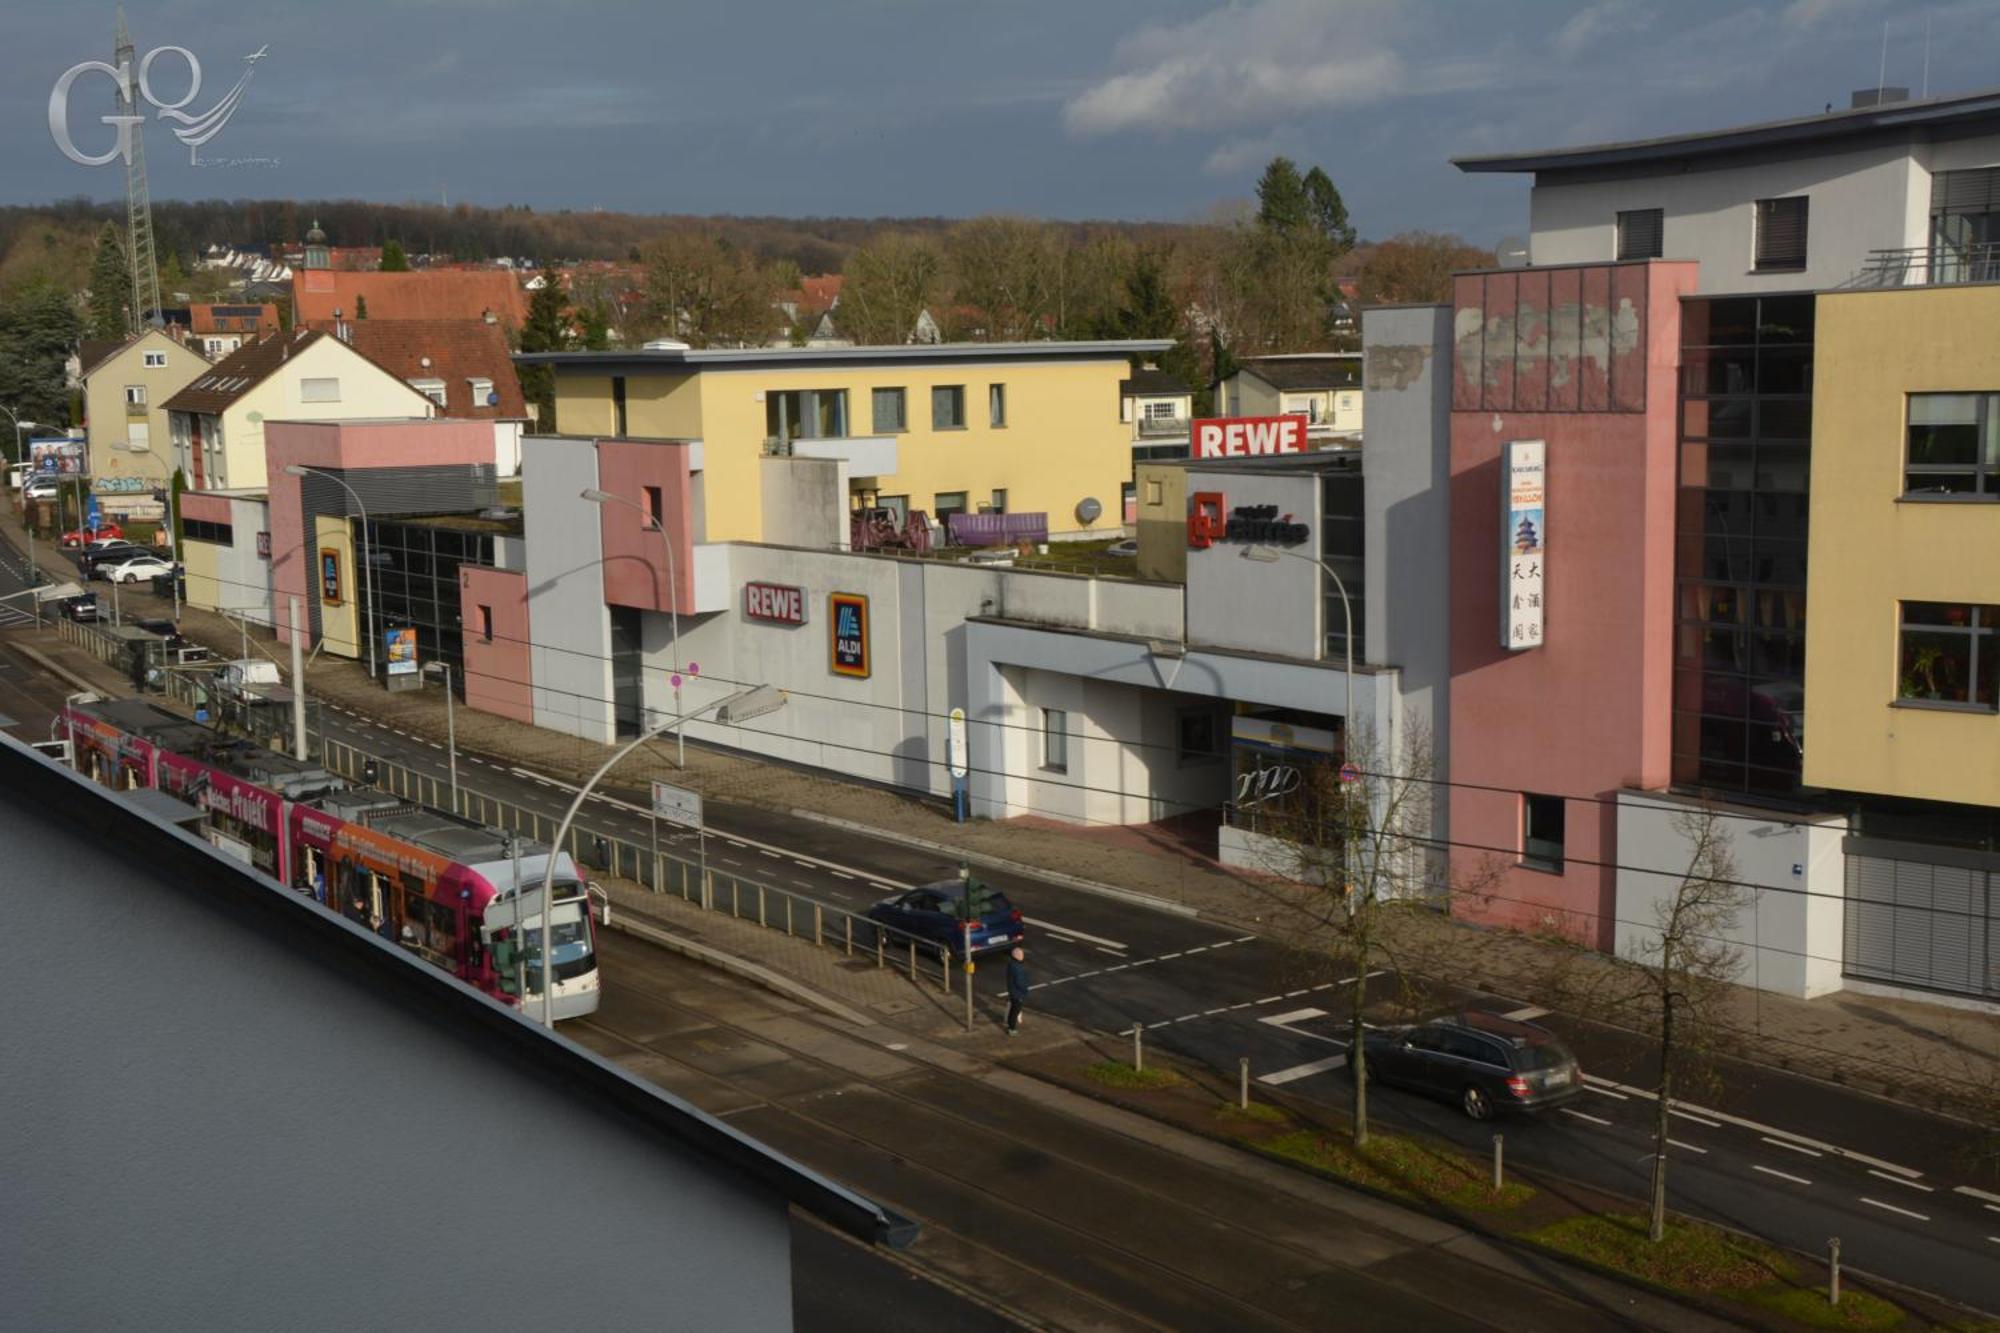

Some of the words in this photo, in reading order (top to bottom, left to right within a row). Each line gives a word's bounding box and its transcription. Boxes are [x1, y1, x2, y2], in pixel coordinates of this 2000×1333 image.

[1200, 421, 1299, 459] REWE
[747, 586, 801, 620] REWE
[837, 640, 861, 654] ALDI
[231, 785, 268, 831] Projekt
